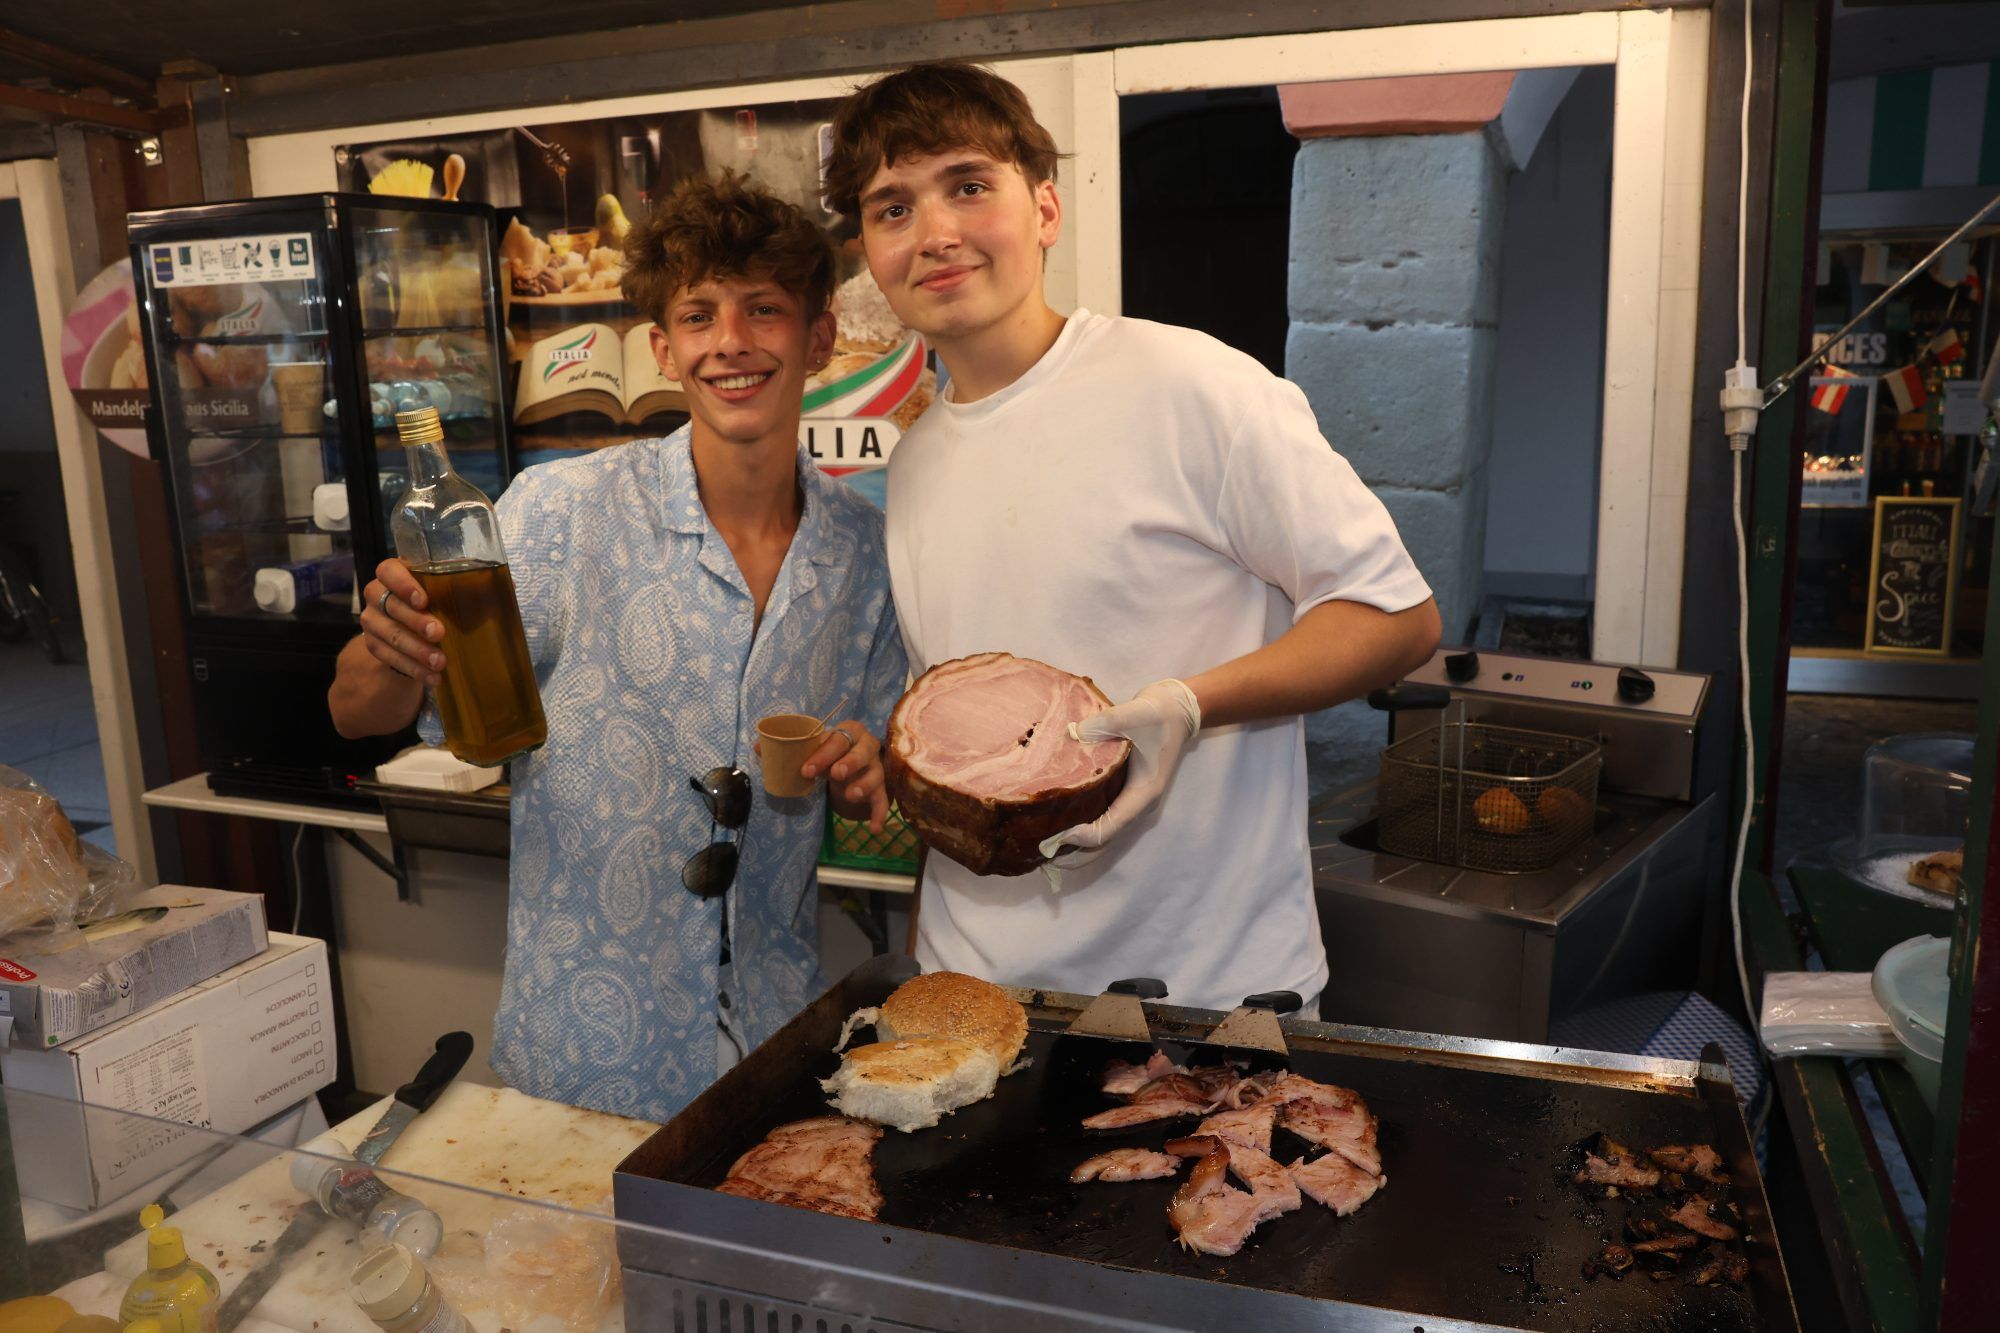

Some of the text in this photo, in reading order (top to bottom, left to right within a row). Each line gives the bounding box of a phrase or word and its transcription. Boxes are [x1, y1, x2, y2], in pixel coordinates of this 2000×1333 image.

[551, 351, 590, 360] ITALIA
[92, 400, 147, 421] Mandelg
[210, 400, 250, 417] Sicilia
[807, 427, 883, 458] LIA
